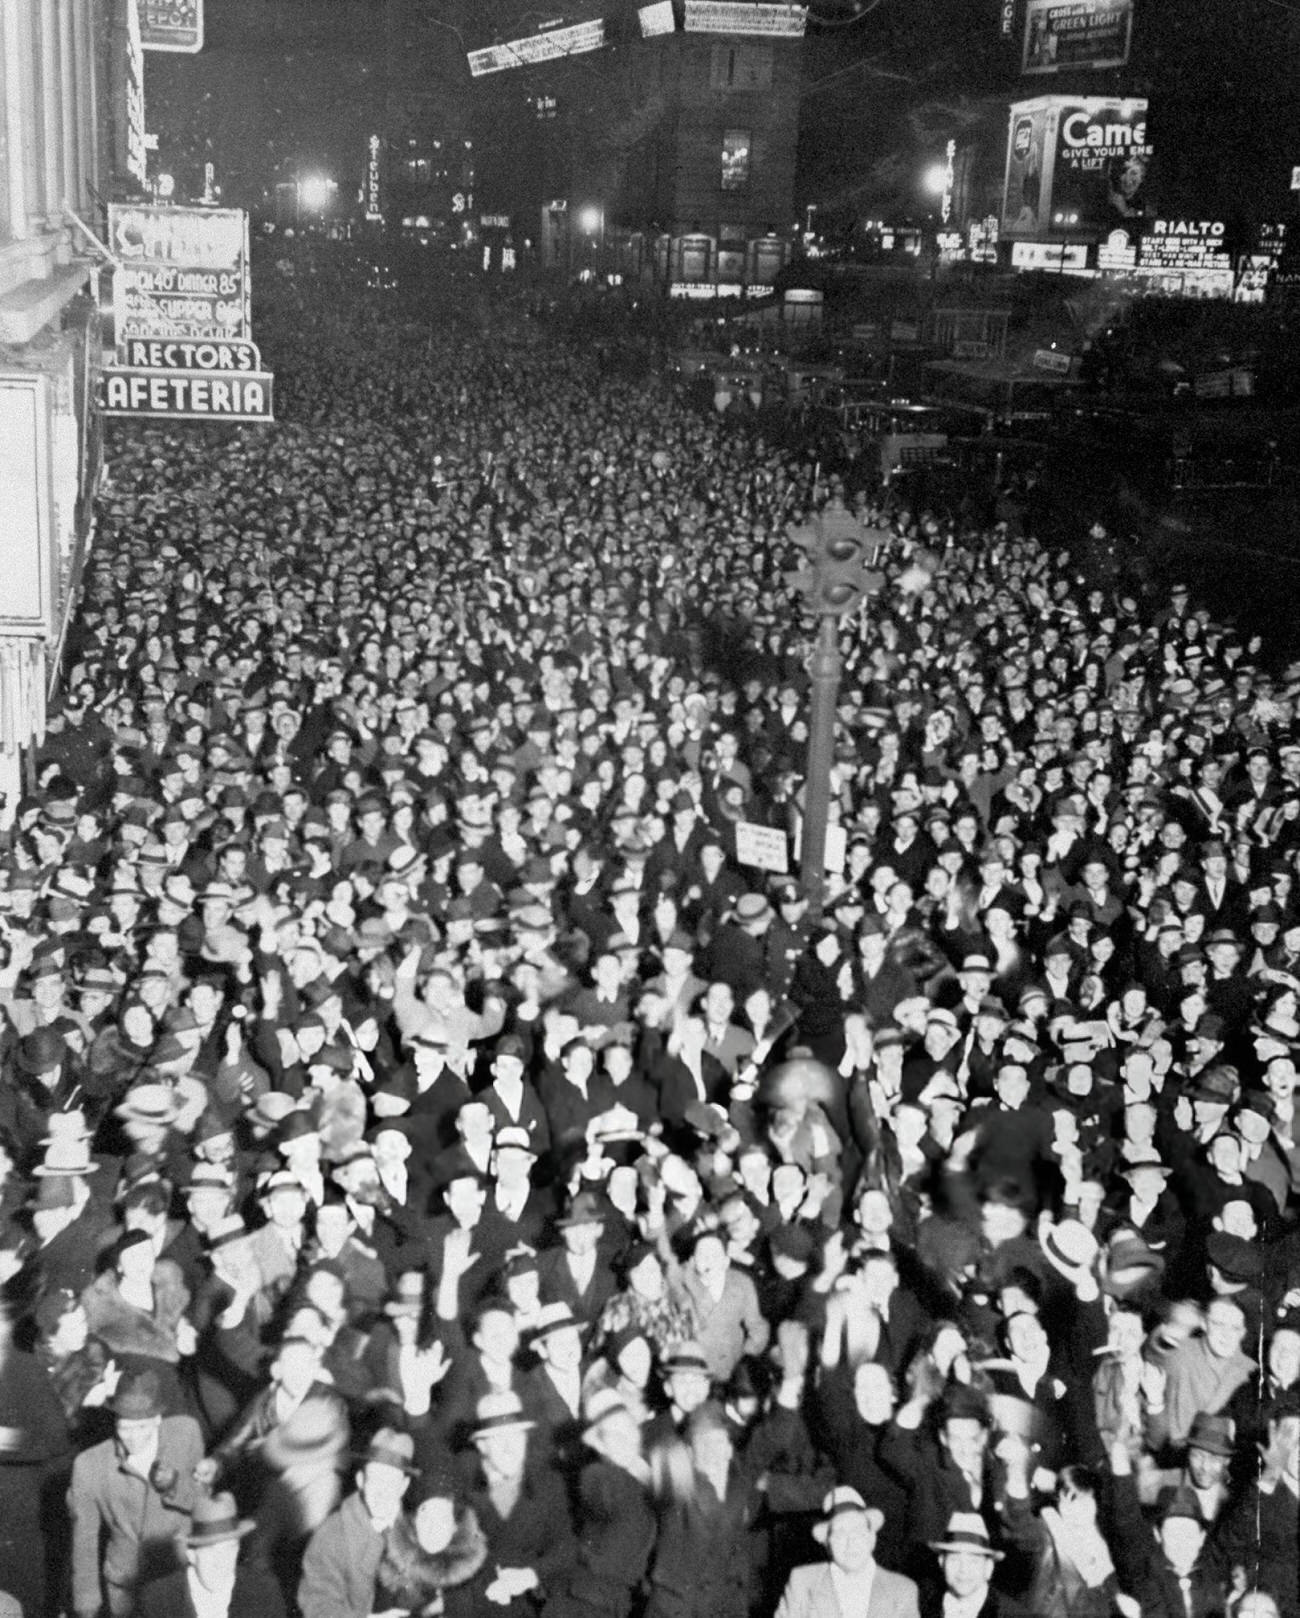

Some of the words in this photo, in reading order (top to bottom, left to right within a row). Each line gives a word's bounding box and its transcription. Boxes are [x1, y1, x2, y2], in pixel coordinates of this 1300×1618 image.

[1002, 0, 1013, 33] GE
[1052, 17, 1087, 31] GREEN
[1089, 12, 1121, 26] LIGHT
[1062, 148, 1090, 158] GIVE
[1093, 146, 1125, 157] YOUR
[1071, 159, 1079, 168] A
[1082, 157, 1105, 170] LIFT
[1154, 220, 1225, 236] RIALTO
[133, 341, 252, 371] RECTOR'S
